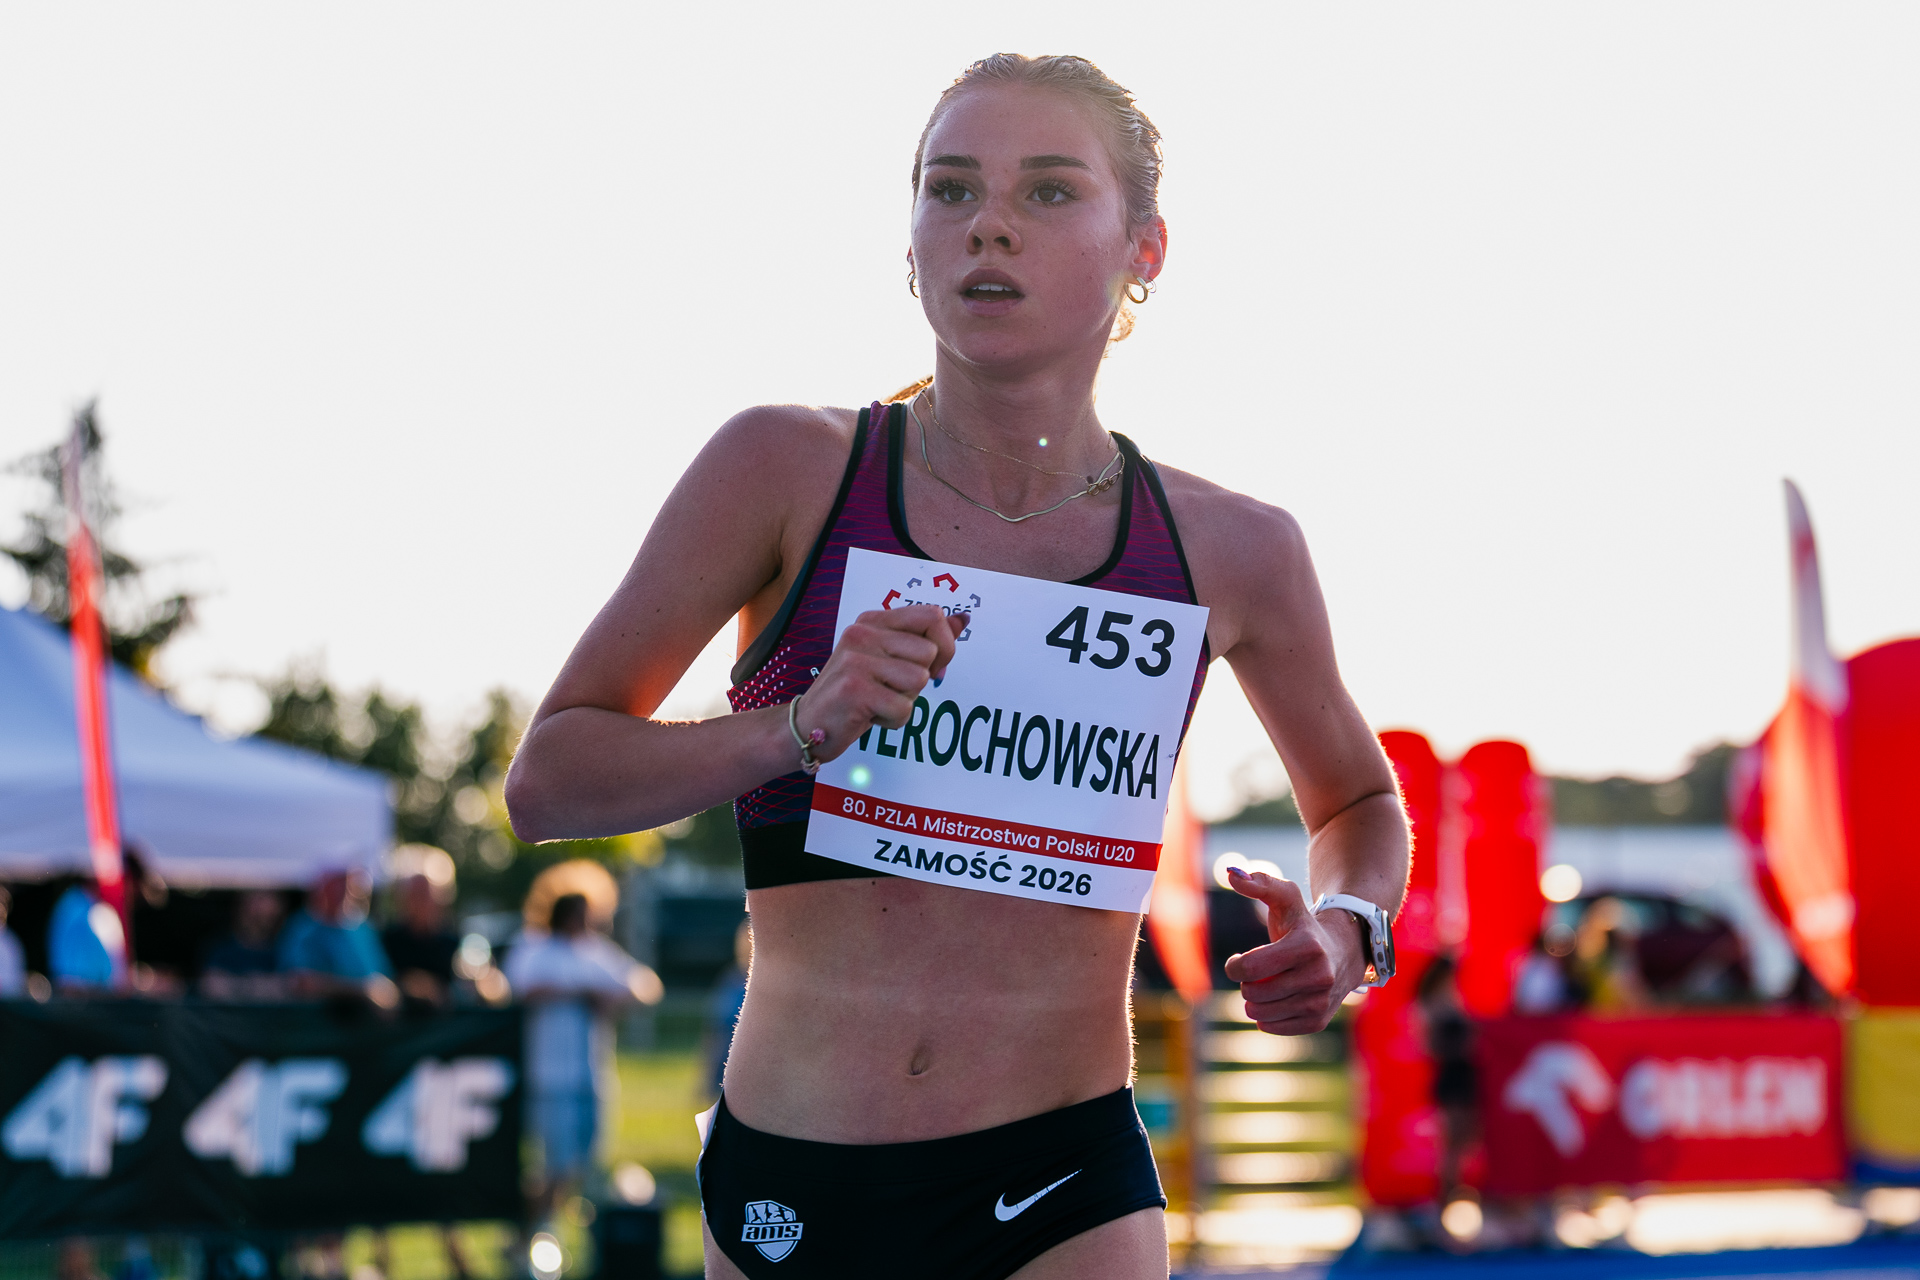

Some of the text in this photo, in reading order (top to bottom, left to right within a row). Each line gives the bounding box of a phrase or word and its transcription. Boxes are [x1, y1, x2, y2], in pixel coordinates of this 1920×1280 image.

[1045, 605, 1175, 677] 453
[858, 695, 1161, 800] ROCHOWSKA
[842, 796, 1135, 863] 80. PZLA Mistrzostwa Polski U20
[873, 838, 1093, 897] ZAMOŚĆ 2026
[1, 1056, 516, 1178] 4F 4F 4F
[745, 1224, 800, 1240] ams
